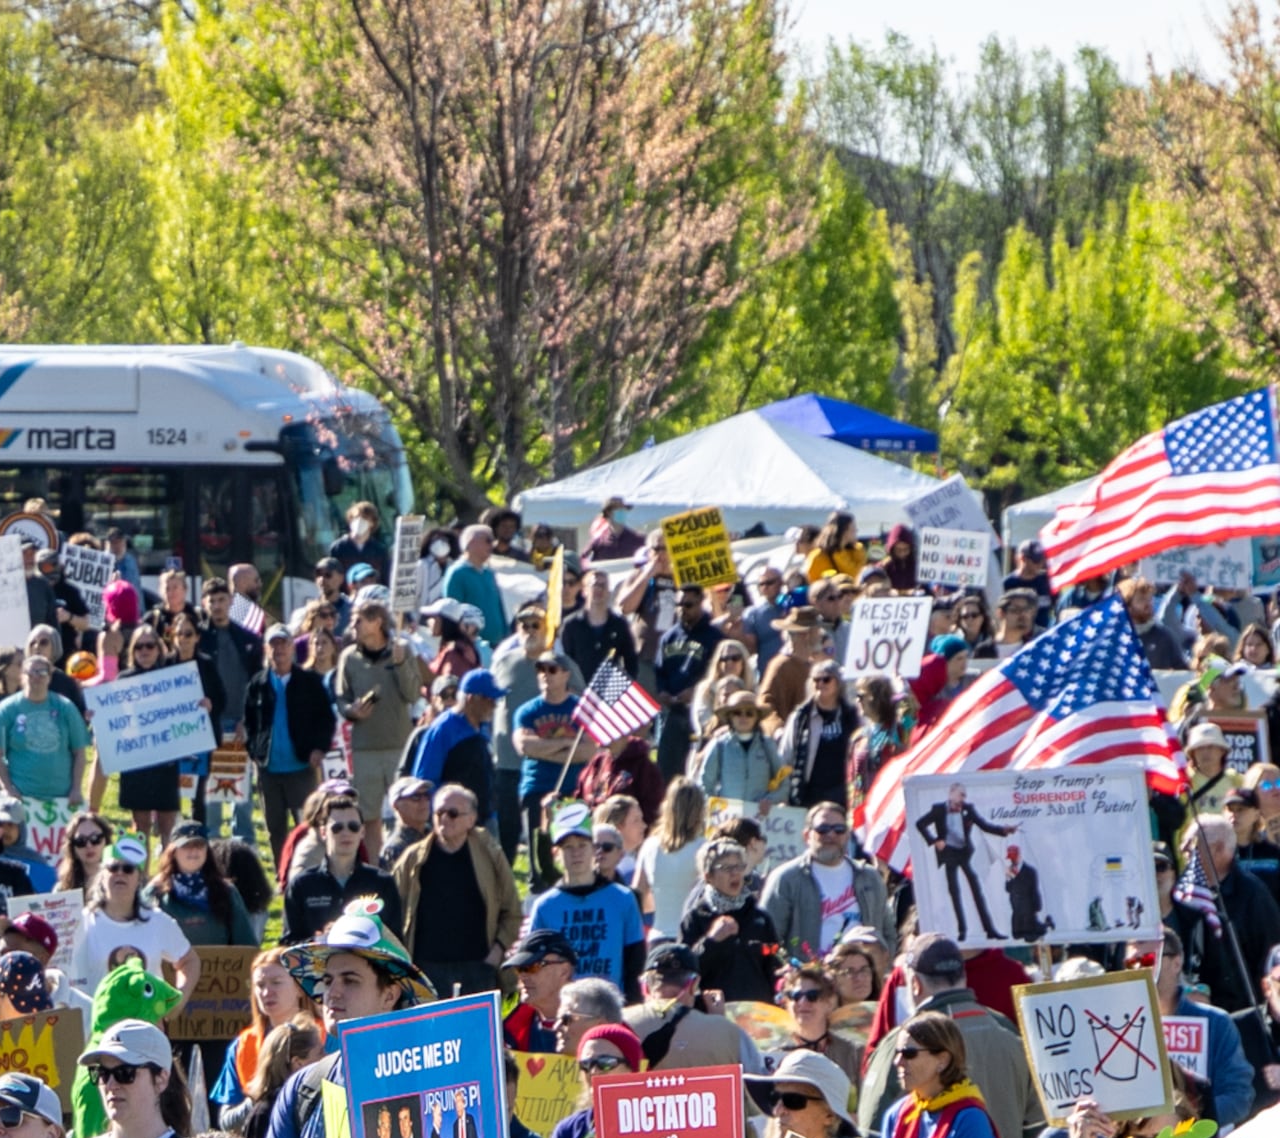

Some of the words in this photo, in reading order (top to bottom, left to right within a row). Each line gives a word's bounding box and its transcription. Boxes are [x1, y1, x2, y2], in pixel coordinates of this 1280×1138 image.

[28, 428, 115, 450] marta
[148, 429, 187, 445] 1524
[665, 508, 722, 537] $200B
[924, 534, 940, 545] NO
[922, 552, 939, 563] NO
[945, 554, 982, 566] WARS
[65, 558, 111, 588] CUBA!
[679, 557, 732, 583] IRAN!
[920, 568, 936, 579] NO
[860, 602, 924, 620] RESIST
[872, 620, 907, 635] WITH
[856, 639, 912, 672] JOY
[109, 716, 131, 732] NOT
[1225, 735, 1255, 748] TOP
[1014, 775, 1046, 790] Stop
[1053, 774, 1106, 788] Trump's
[1013, 791, 1087, 804] SURRENDER
[1092, 789, 1107, 801] to
[991, 805, 1041, 819] Vladimir
[1046, 802, 1087, 817] Adolf
[1094, 800, 1138, 814] Putin!
[563, 909, 570, 924] I
[573, 909, 593, 924] AM
[595, 908, 606, 922] A
[561, 925, 608, 941] FORCE
[1035, 1003, 1076, 1039] NO
[374, 1046, 423, 1078] JUDGE
[423, 1043, 443, 1069] ME
[444, 1038, 462, 1064] BY
[1040, 1067, 1095, 1102] KINGS
[617, 1092, 717, 1133] DICTATOR
